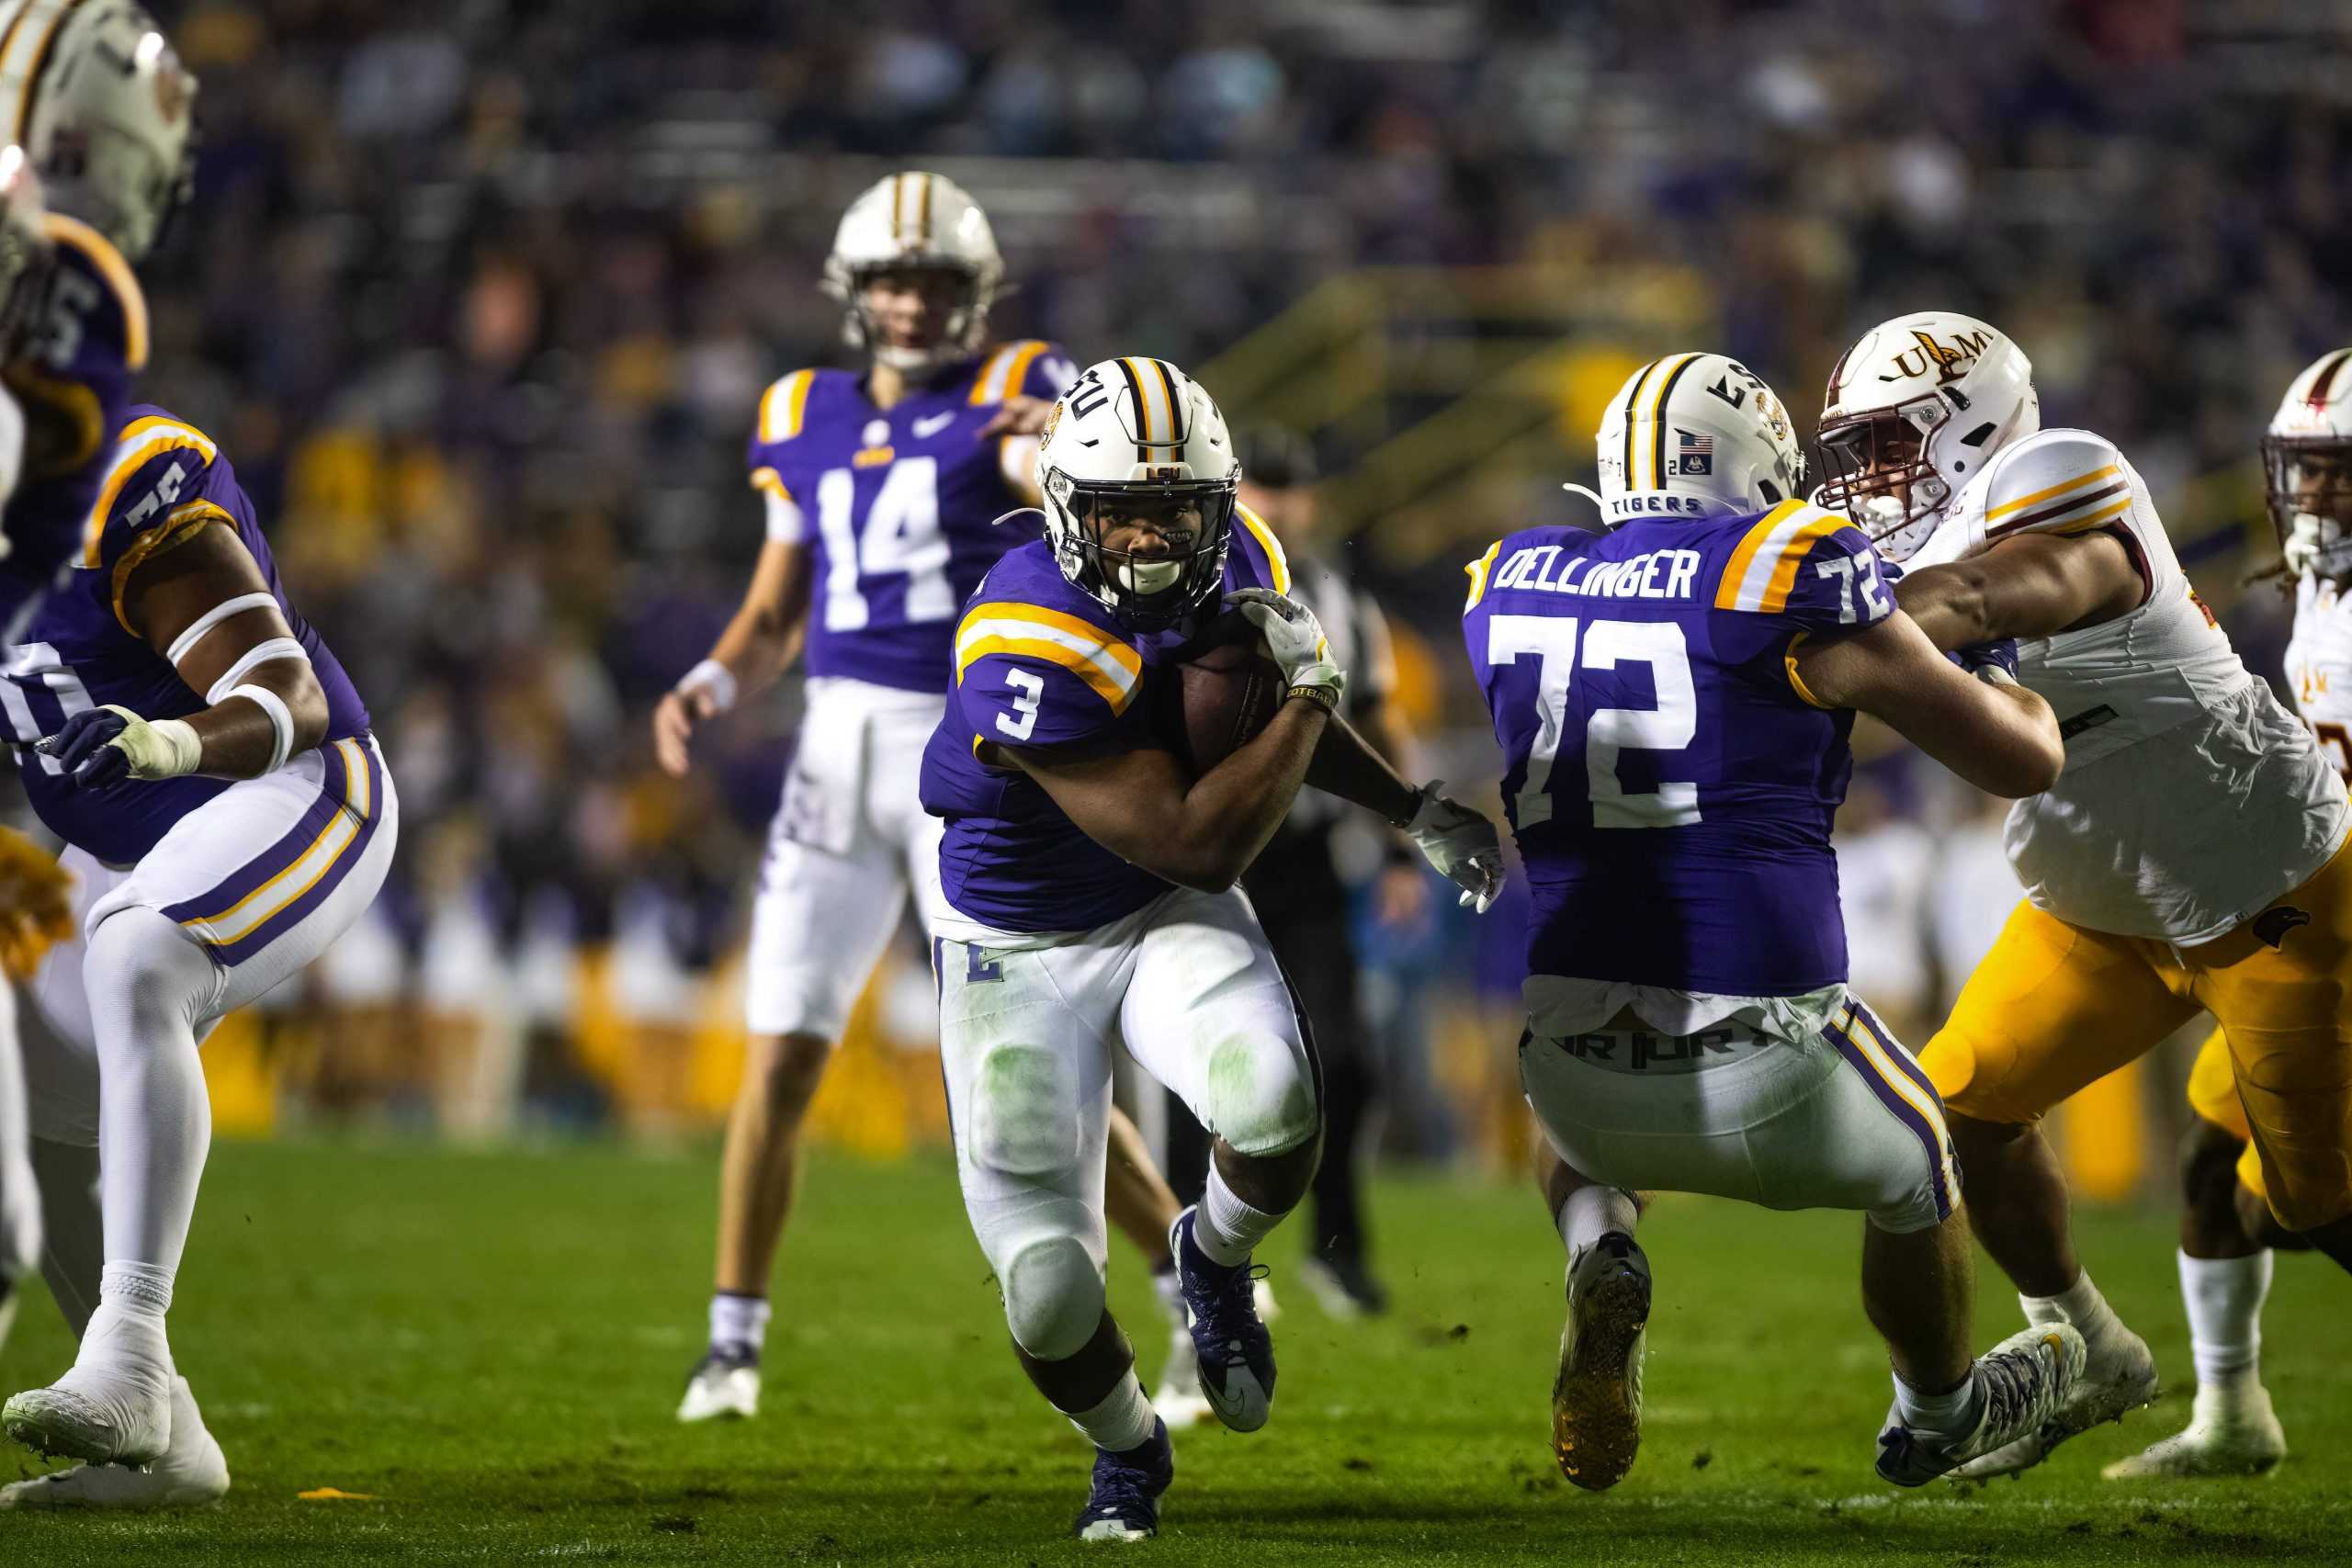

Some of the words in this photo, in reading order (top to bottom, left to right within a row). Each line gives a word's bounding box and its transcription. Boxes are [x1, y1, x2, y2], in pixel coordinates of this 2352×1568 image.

[1611, 496, 1702, 515] TIGERS
[817, 456, 958, 633] 14
[1492, 544, 1702, 599] DELLINGER
[1815, 548, 1891, 626] 72
[995, 667, 1045, 741] 3
[1487, 614, 1704, 830] 72
